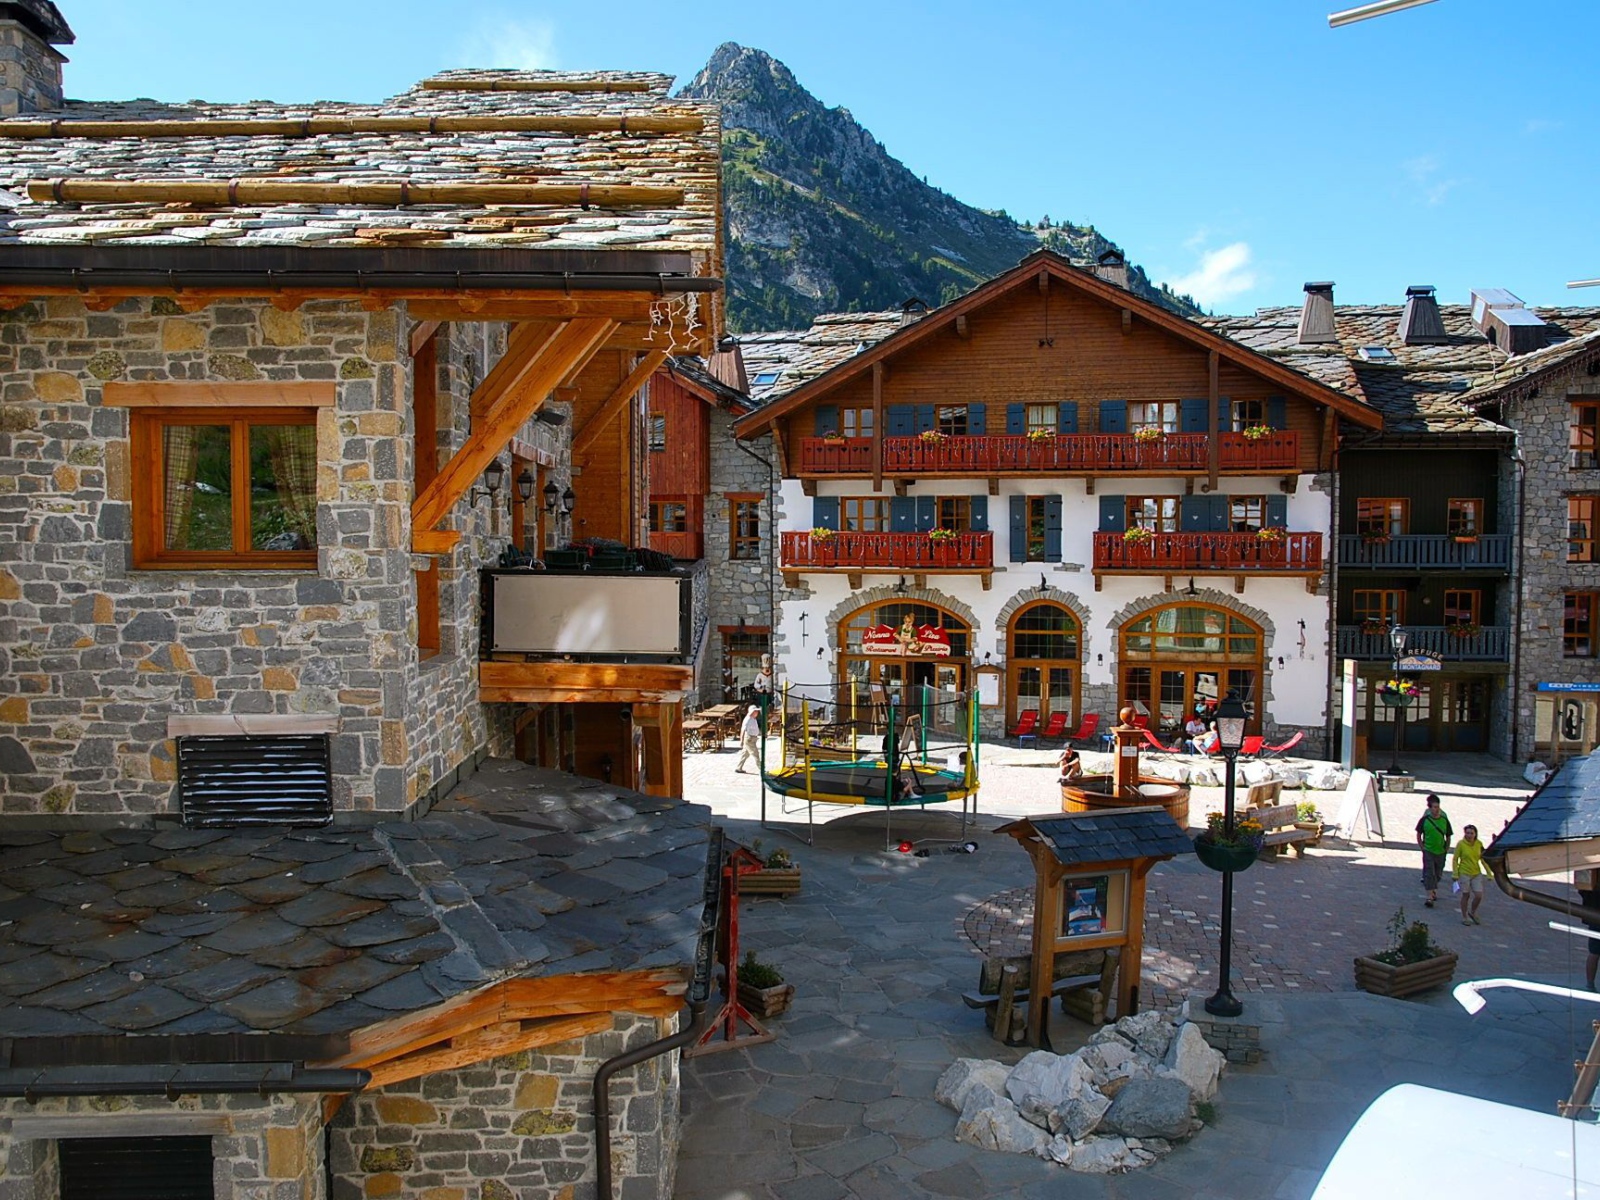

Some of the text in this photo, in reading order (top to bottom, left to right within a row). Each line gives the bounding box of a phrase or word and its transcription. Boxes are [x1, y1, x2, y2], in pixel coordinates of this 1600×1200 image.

[864, 630, 940, 640] Nonna Lisa
[1407, 648, 1444, 661] REFUGE
